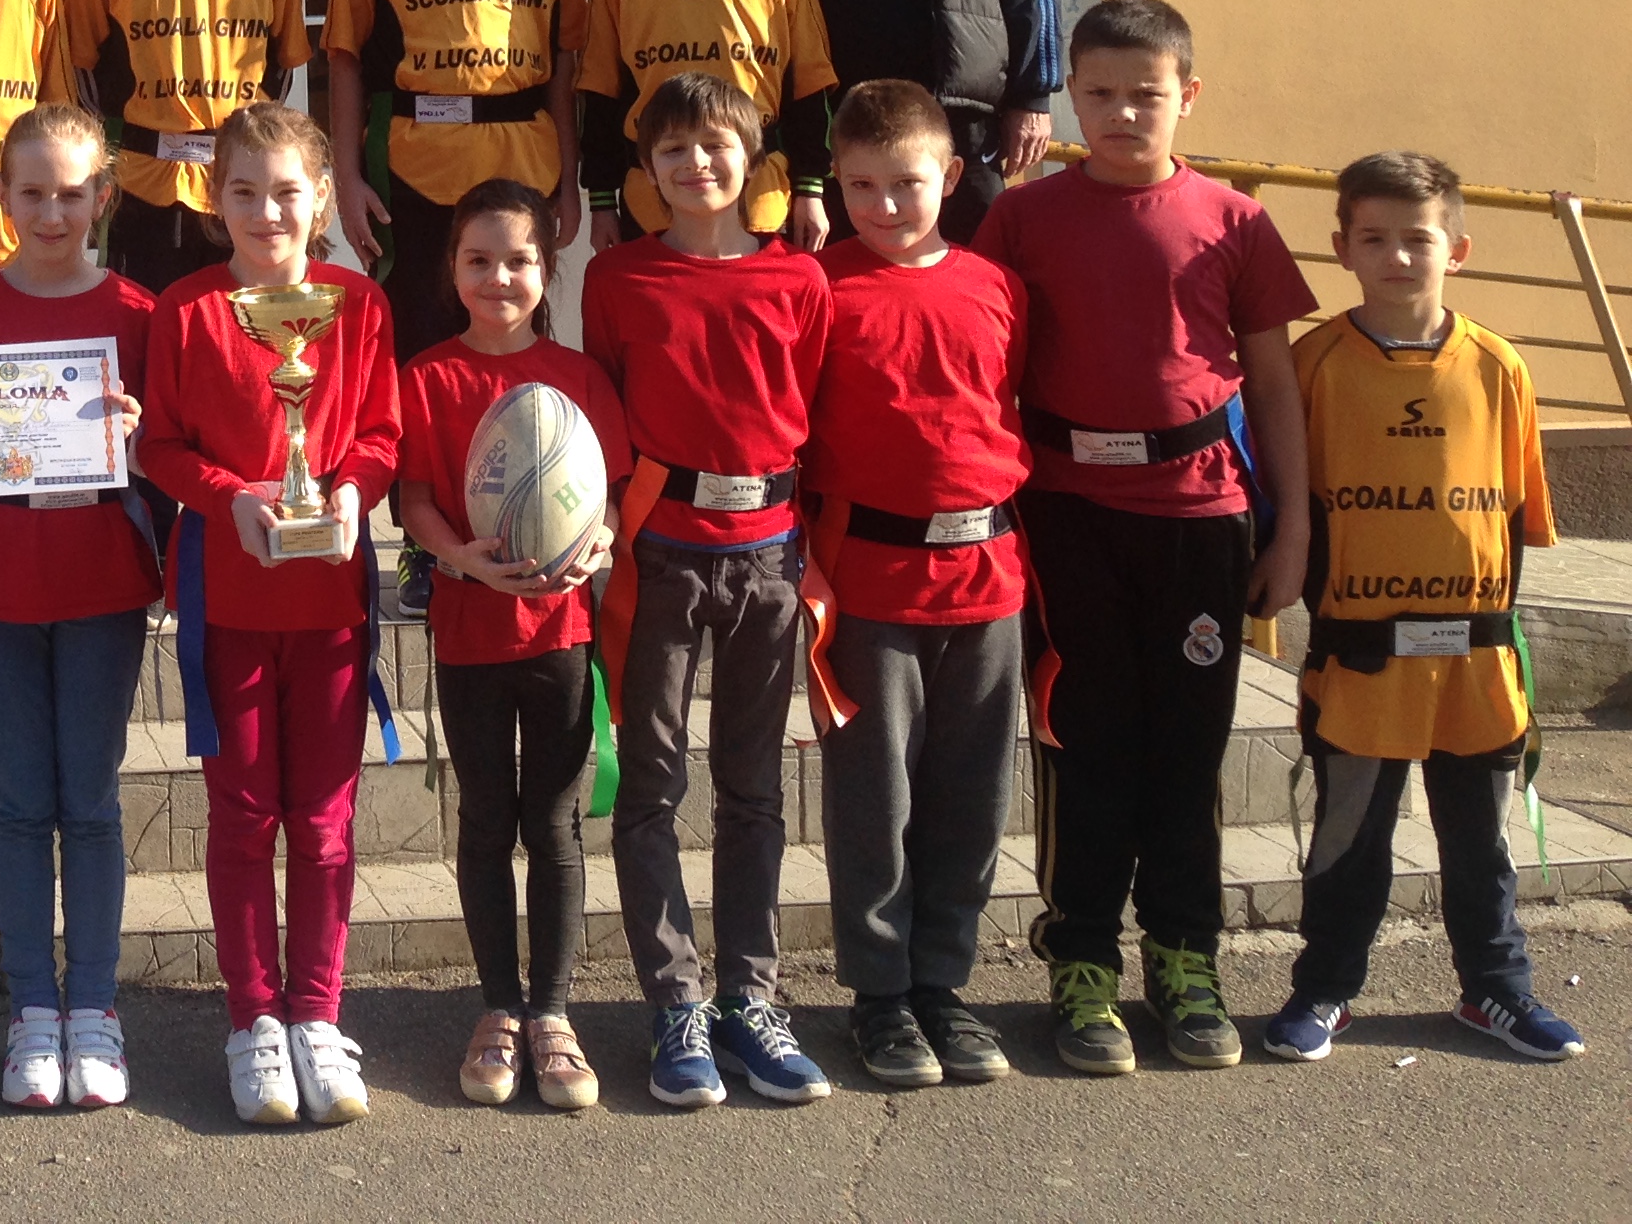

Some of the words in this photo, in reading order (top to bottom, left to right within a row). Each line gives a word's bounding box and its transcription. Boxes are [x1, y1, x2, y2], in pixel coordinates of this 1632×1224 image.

[129, 17, 206, 41] SCOALA
[413, 53, 426, 70] V.
[434, 47, 524, 69] LUCACIU
[634, 41, 721, 70] SCOALA
[154, 78, 233, 99] LUCACIU
[1386, 425, 1446, 438] salta
[470, 439, 506, 498] adidas
[1326, 485, 1436, 514] SCOALA
[1346, 576, 1470, 600] LUCACIU
